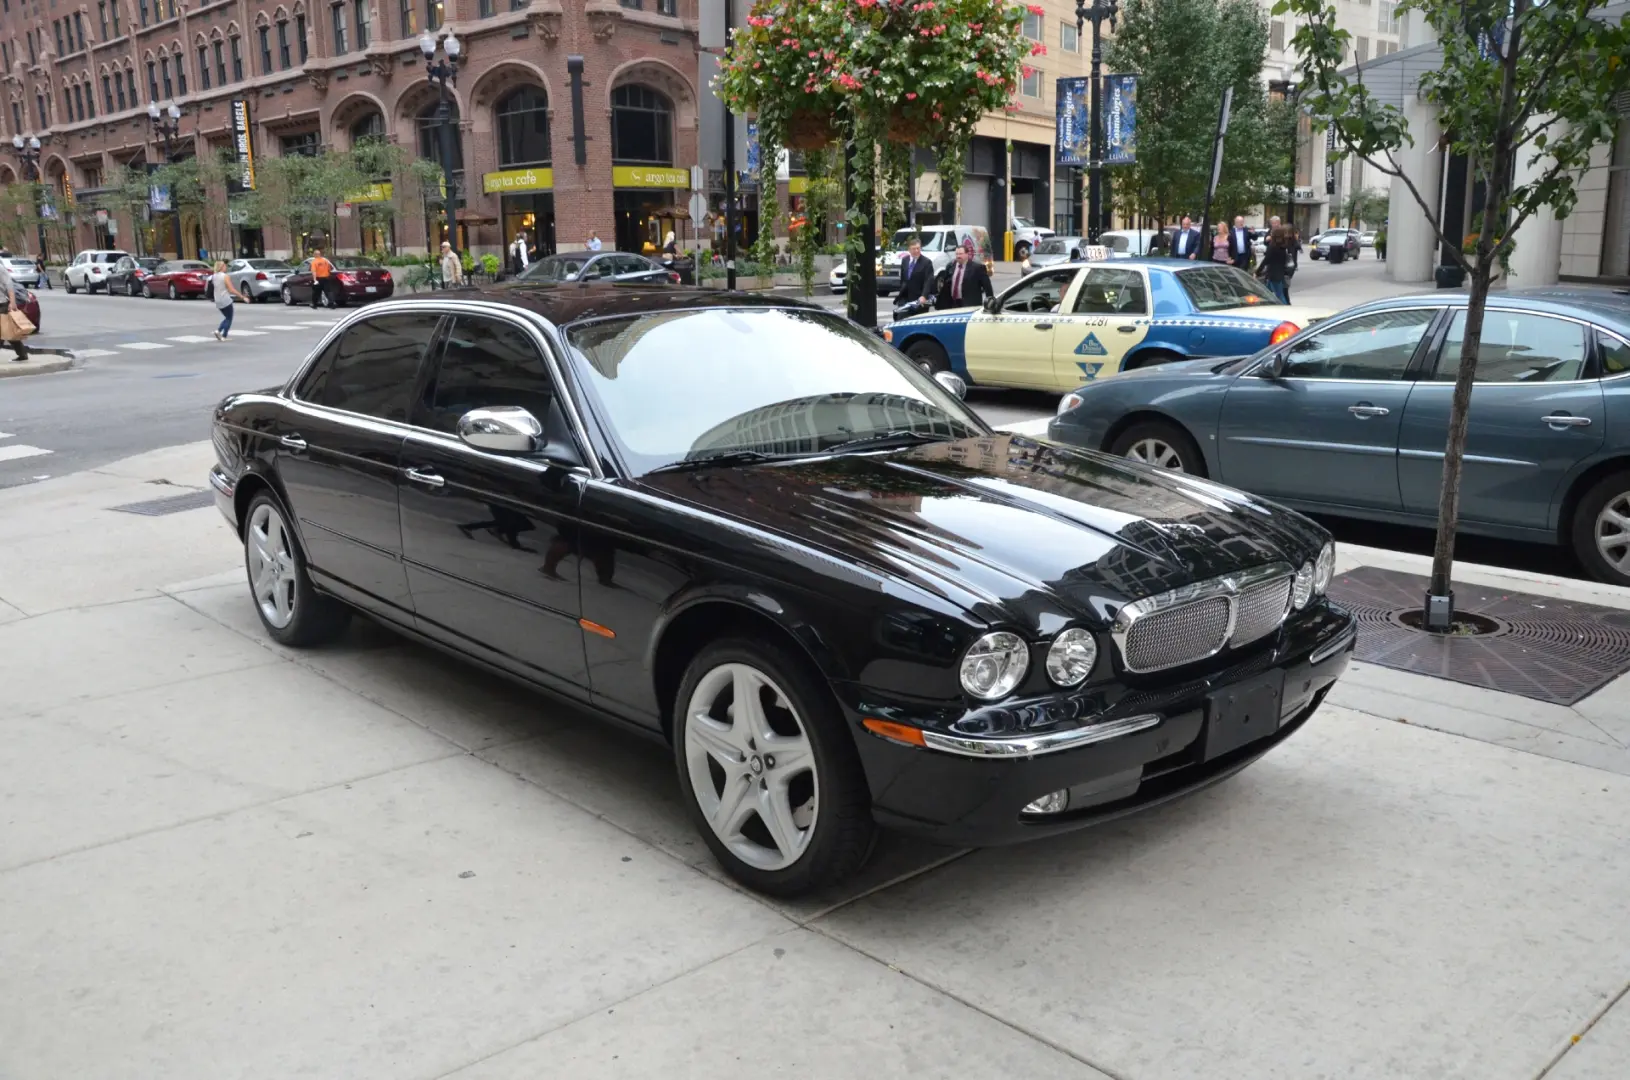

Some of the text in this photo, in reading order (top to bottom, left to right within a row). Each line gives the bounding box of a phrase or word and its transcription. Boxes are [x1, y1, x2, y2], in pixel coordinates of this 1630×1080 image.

[234, 101, 246, 131] BAGELS
[1064, 92, 1074, 148] Cosmologies
[1112, 88, 1122, 146] Cosmologies
[645, 173, 664, 185] argo
[1085, 316, 1109, 327] 2281
